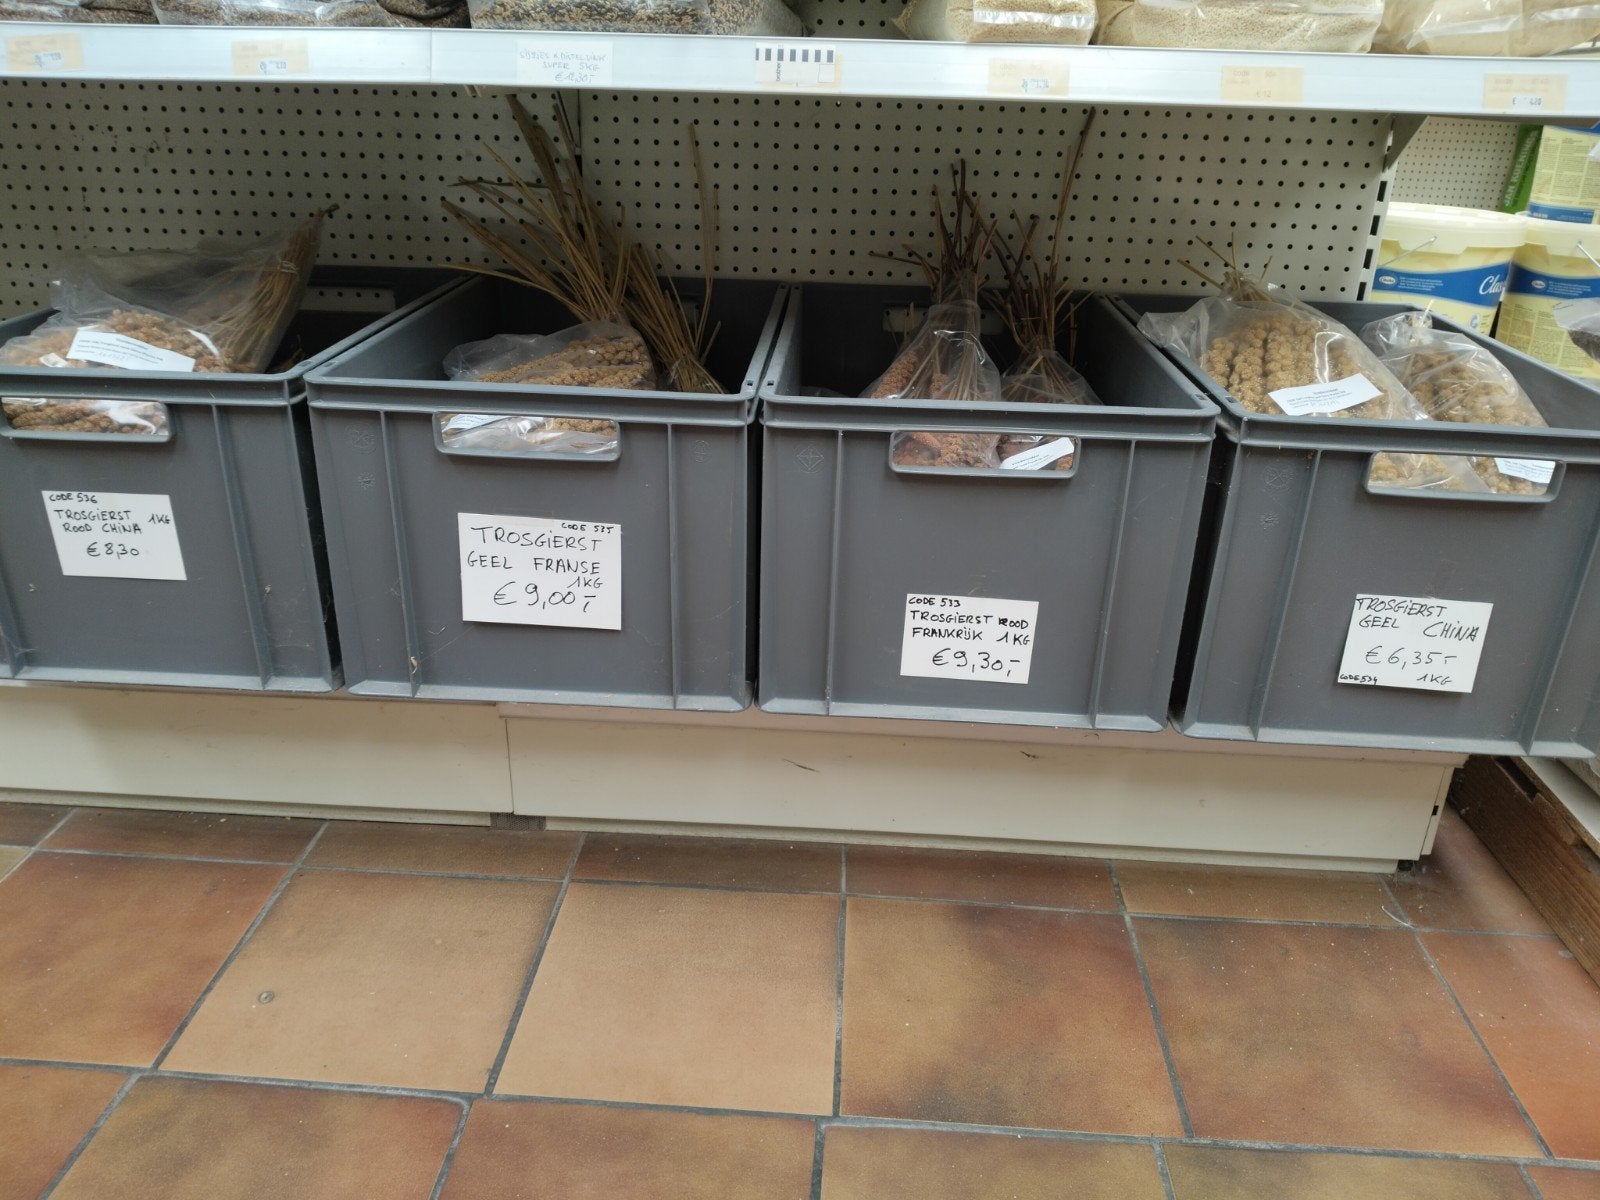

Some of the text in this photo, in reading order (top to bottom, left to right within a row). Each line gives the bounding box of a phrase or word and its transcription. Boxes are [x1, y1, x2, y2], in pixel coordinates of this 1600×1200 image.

[49, 492, 73, 502] CODE
[62, 522, 92, 533] ROOD
[561, 523, 587, 532] CODE
[467, 550, 601, 575] GEEL FRANSE
[908, 596, 961, 608] CODE 533
[1359, 614, 1400, 629] GEEL
